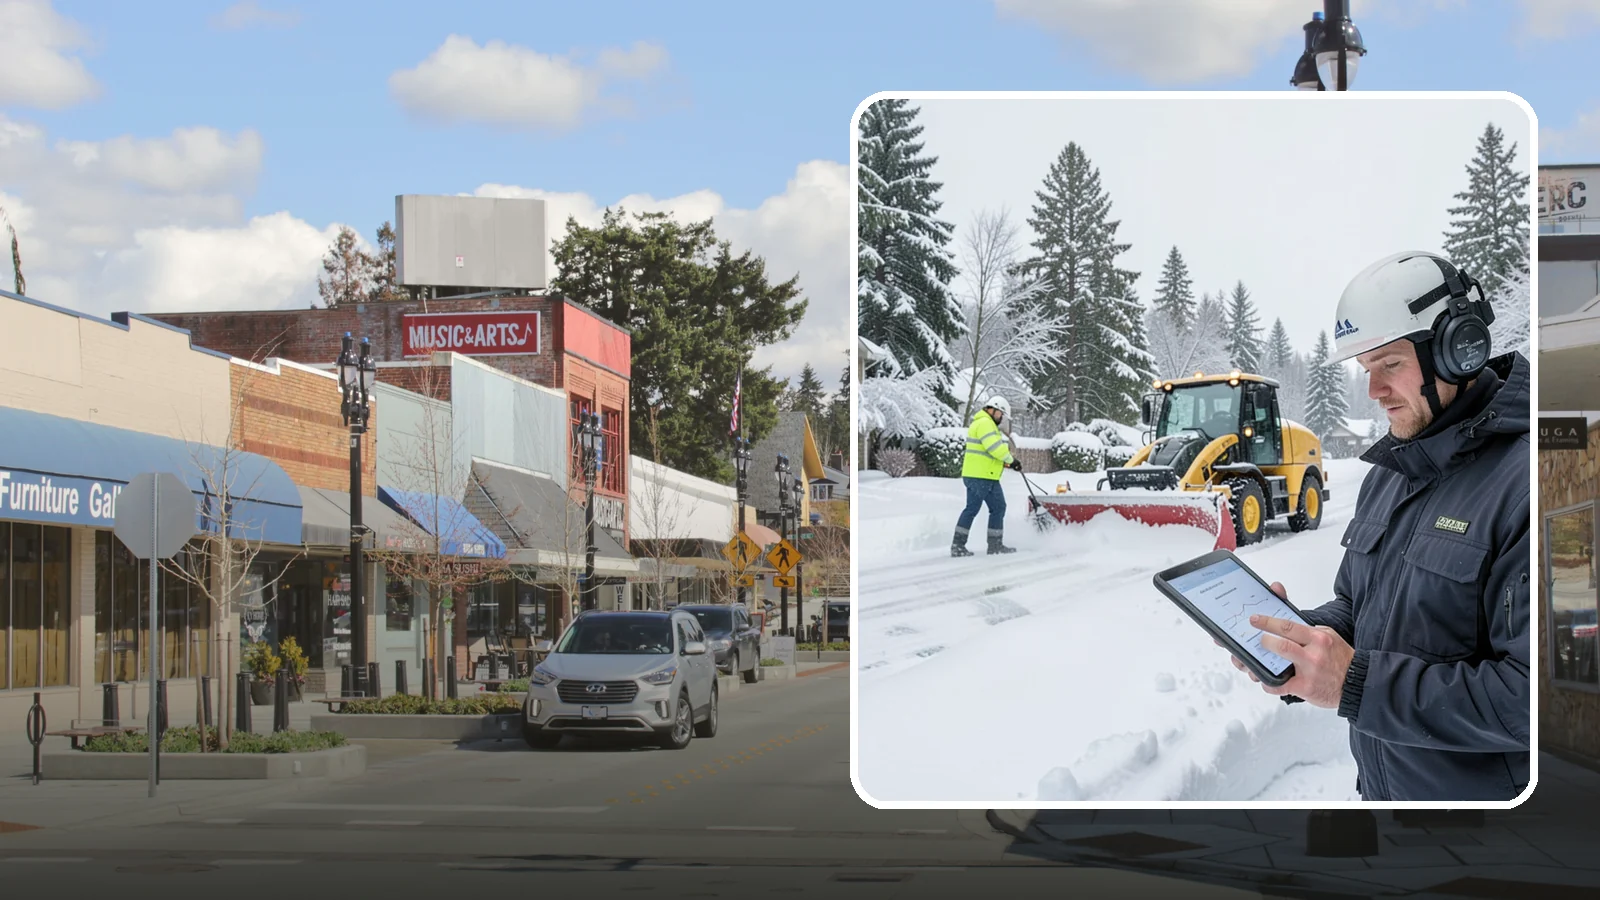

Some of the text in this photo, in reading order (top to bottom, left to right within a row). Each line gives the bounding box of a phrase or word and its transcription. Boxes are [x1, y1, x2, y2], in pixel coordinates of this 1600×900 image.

[1540, 427, 1577, 437] UGA
[0, 471, 122, 519] Furniture Gal
[453, 563, 479, 574] SUSHI
